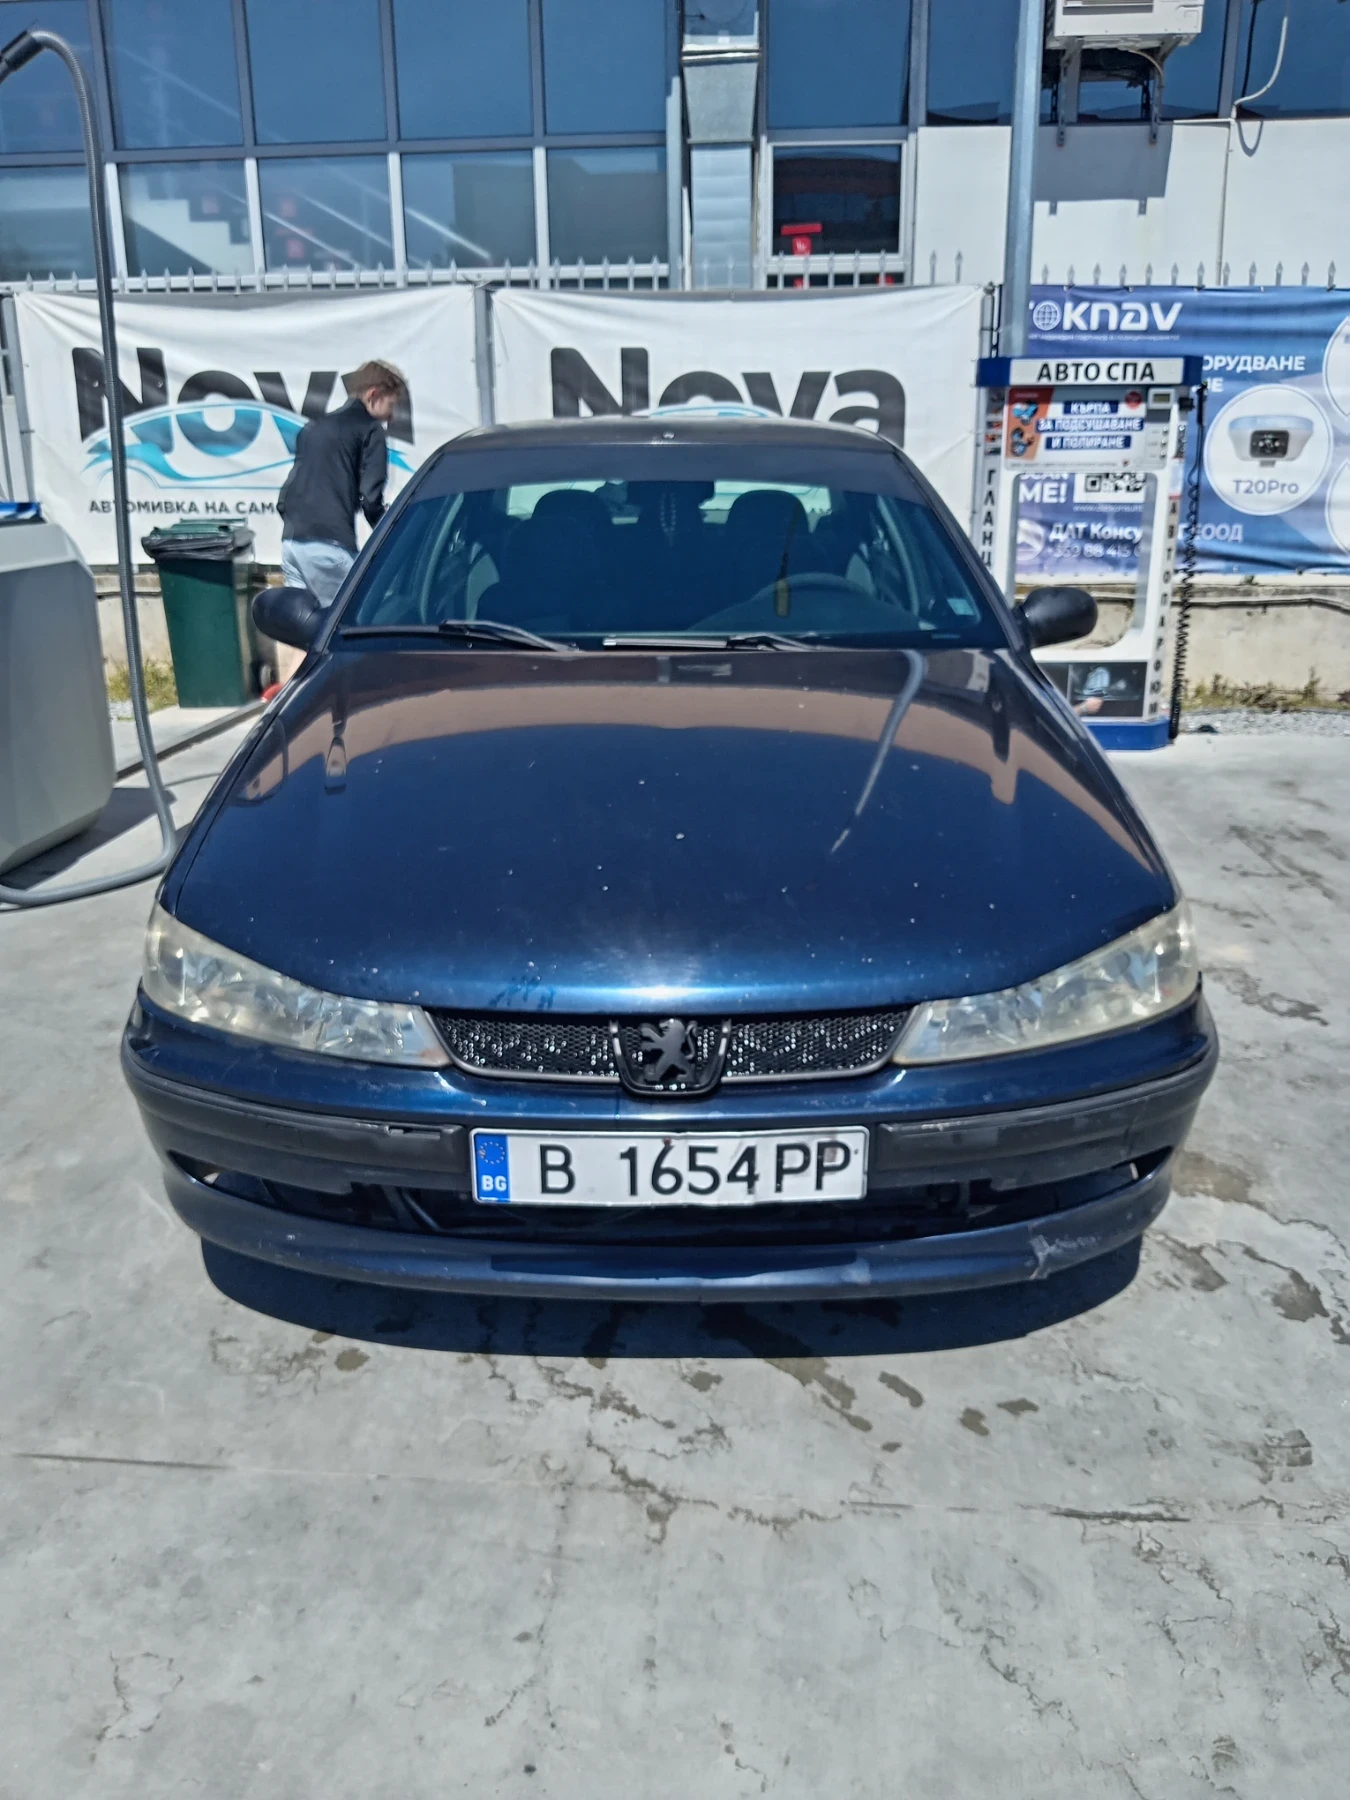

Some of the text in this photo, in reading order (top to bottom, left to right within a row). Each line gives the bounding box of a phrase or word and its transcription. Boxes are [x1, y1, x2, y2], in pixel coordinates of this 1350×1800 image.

[1037, 362, 1156, 382] АВТО СПА
[1038, 418, 1053, 432] ЗА
[1018, 481, 1068, 504] ME!
[1233, 479, 1299, 495] T20Pro
[89, 500, 200, 514] АВОМИВКА
[205, 500, 231, 514] НА
[1049, 522, 1088, 542] ДАТ
[539, 1143, 576, 1195] B
[481, 1176, 507, 1192] BG
